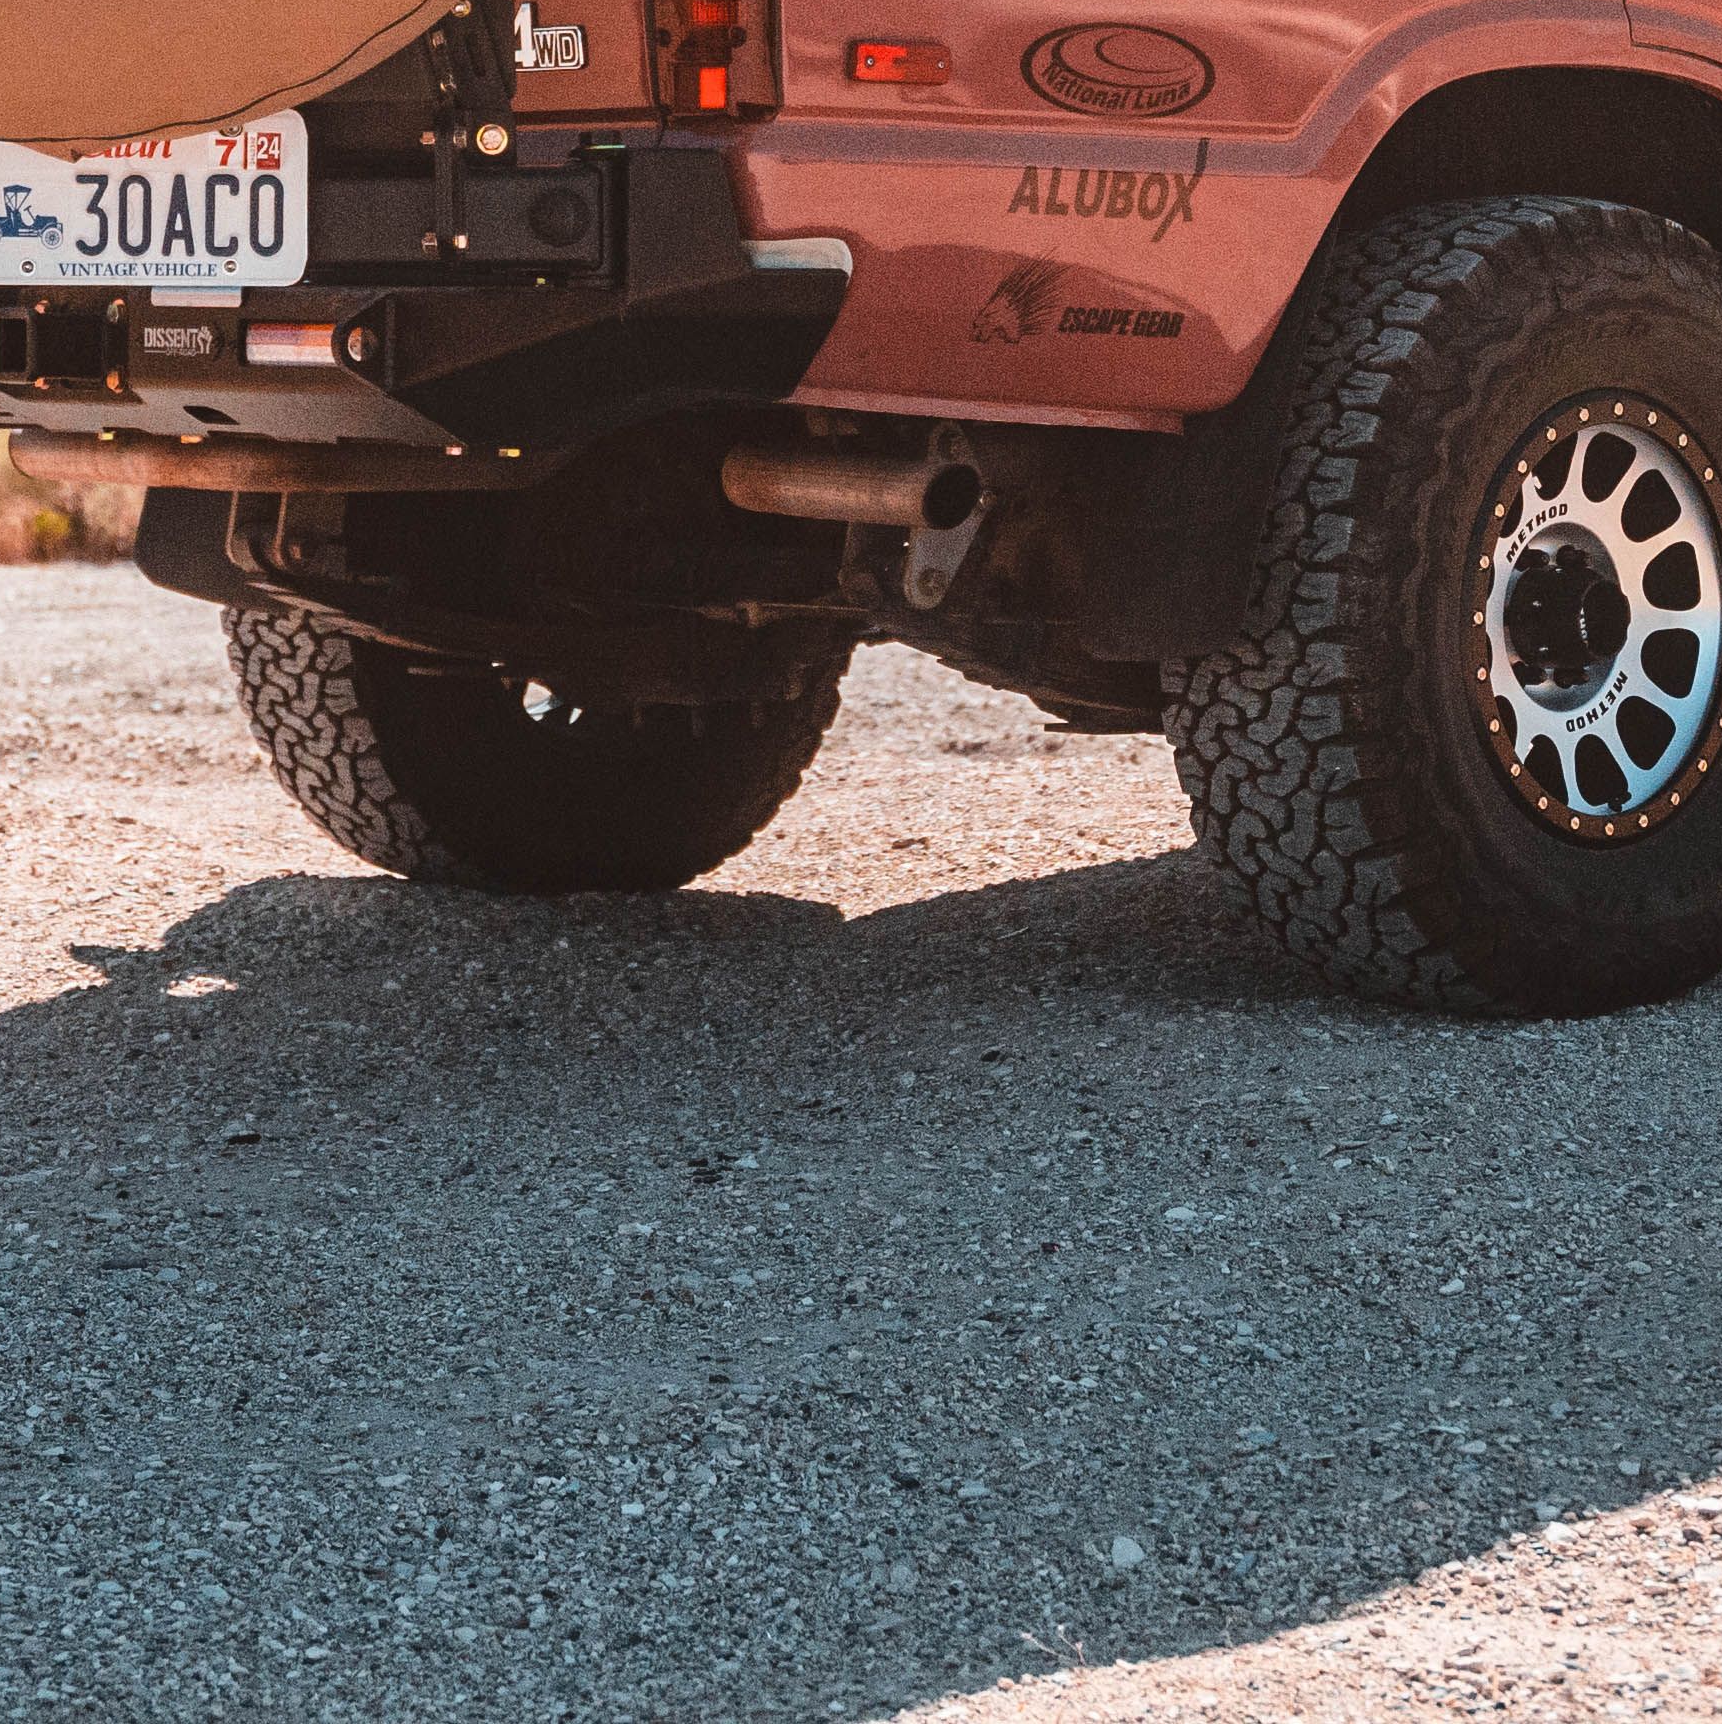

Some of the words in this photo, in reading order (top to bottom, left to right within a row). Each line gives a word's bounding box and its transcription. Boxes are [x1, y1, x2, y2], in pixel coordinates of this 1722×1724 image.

[1041, 61, 1129, 109] National
[1132, 81, 1192, 110] Luna
[215, 139, 237, 167] 7
[257, 136, 280, 160] 24
[1007, 137, 1211, 243] ALUBOX
[58, 262, 139, 277] VINTAGE
[141, 262, 218, 277] VEHICLE
[143, 327, 199, 349] DISSENT
[1058, 306, 1134, 335] ESCAPE
[1132, 309, 1186, 338] GEAR
[1505, 502, 1569, 564] METHOD
[1565, 670, 1629, 733] METHOD
